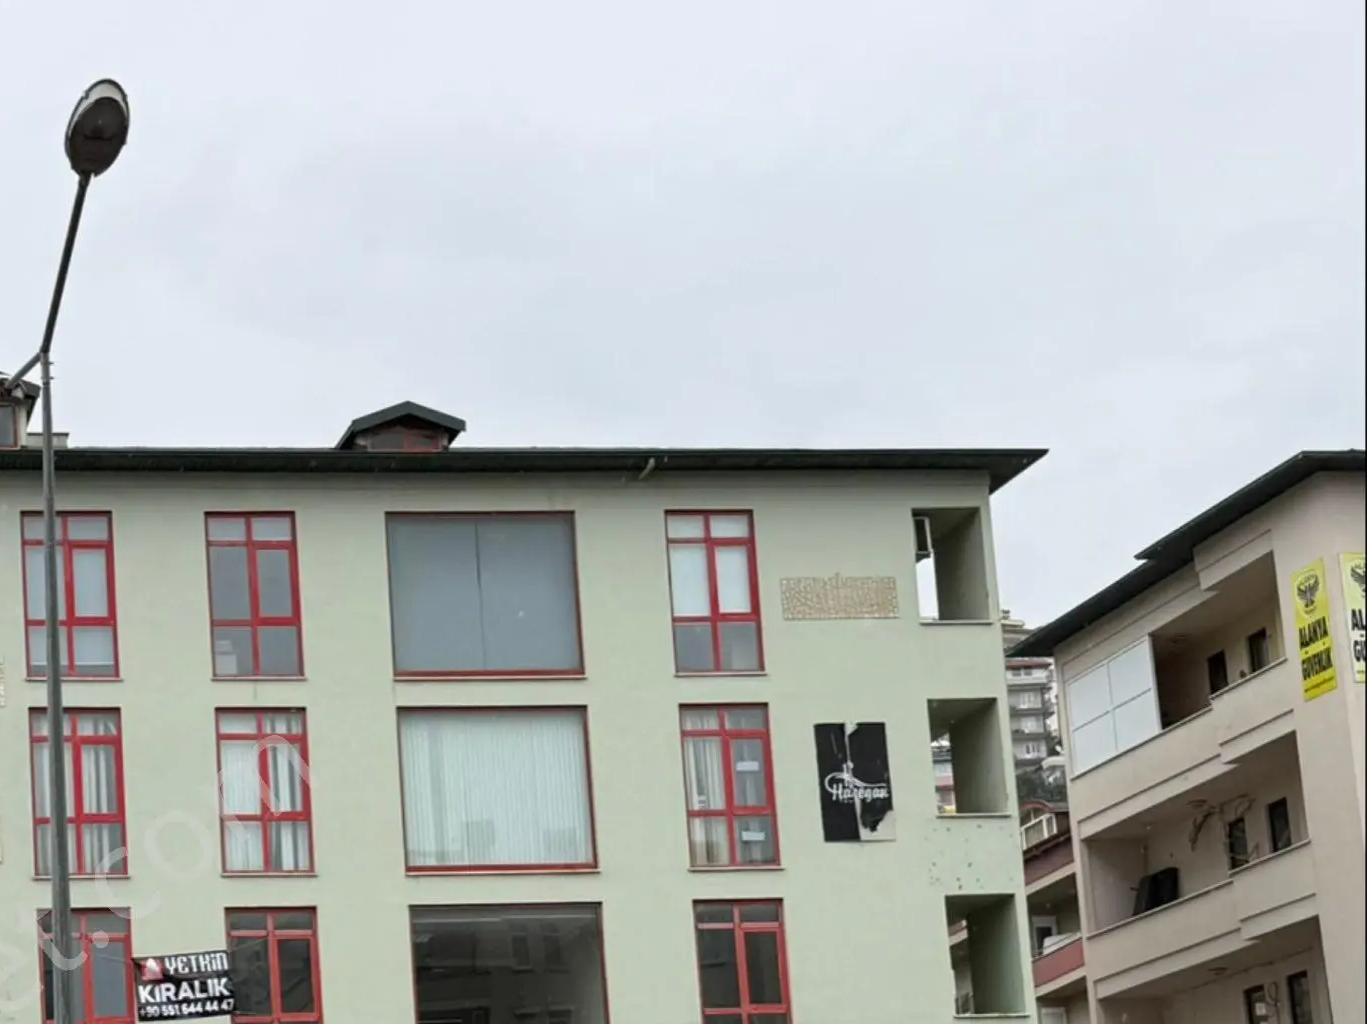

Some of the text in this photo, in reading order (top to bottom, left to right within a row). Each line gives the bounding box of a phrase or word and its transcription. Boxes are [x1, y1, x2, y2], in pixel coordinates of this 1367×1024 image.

[138, 977, 231, 1003] KIRALIK
[139, 1006, 160, 1018] +90
[205, 1001, 219, 1012] 44
